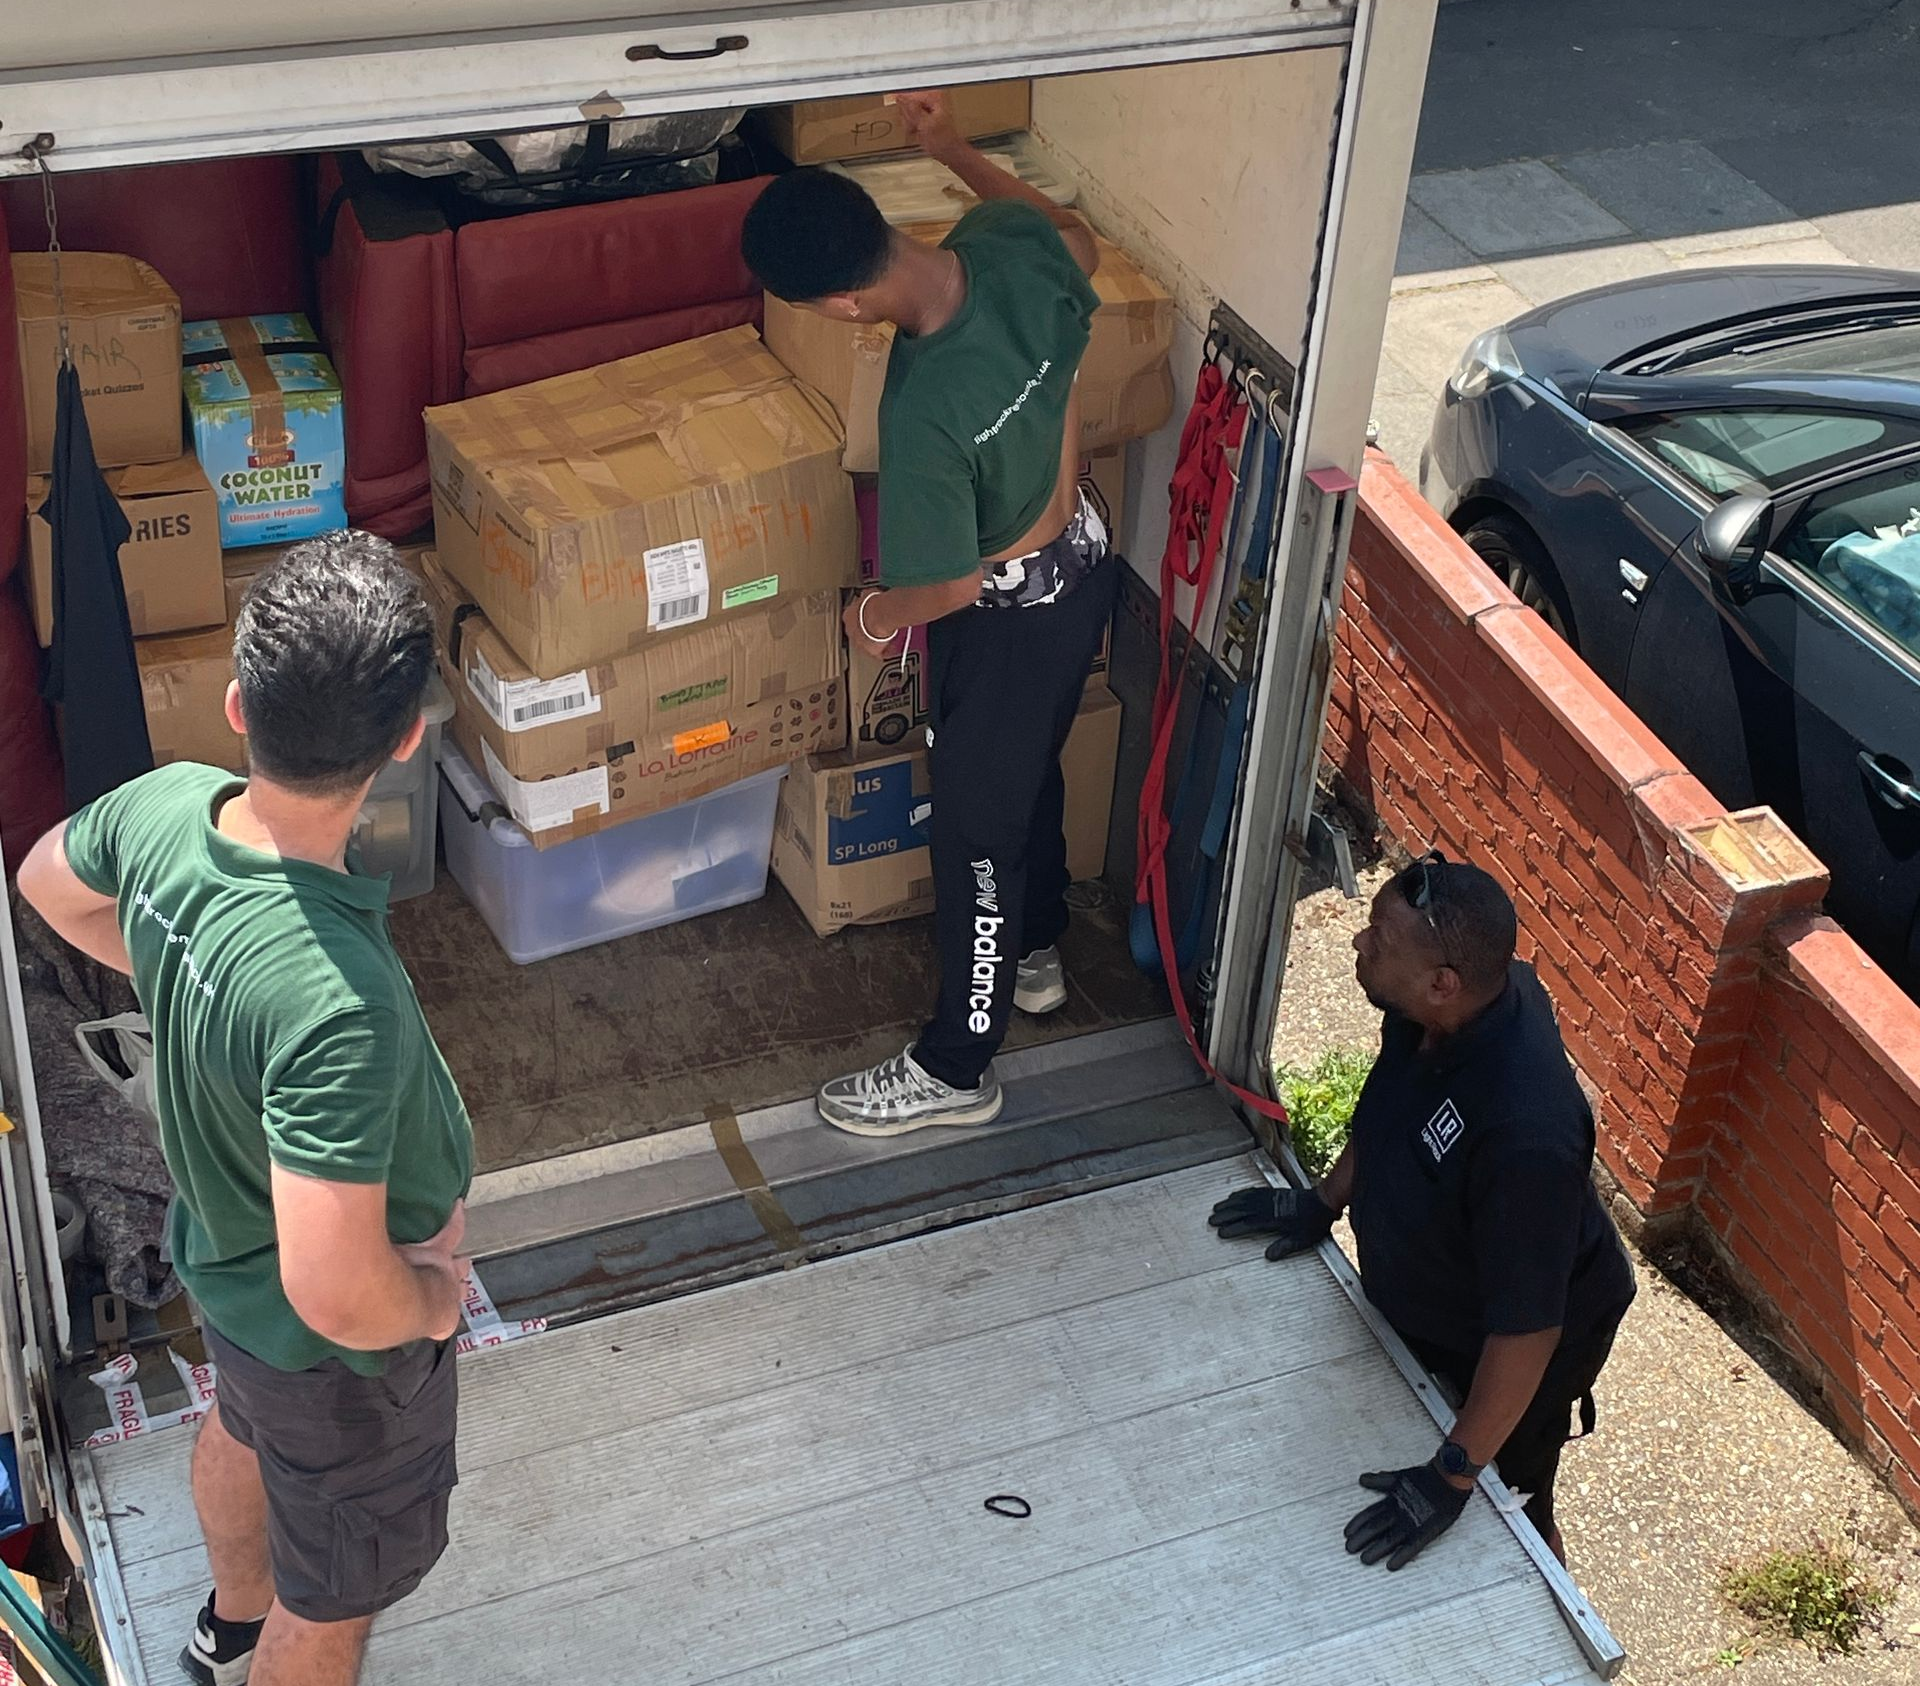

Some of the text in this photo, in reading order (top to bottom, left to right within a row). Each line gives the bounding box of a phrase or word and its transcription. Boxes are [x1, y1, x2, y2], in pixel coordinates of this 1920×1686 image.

[850, 119, 893, 147] FD
[53, 336, 142, 379] HAIR
[220, 463, 322, 490] COCONUT
[234, 483, 311, 506] WATER
[134, 513, 192, 542] RIES
[229, 505, 321, 523] Ultimate Hydration
[636, 761, 665, 778] La
[669, 729, 759, 769] Lorraine
[852, 776, 882, 796] lus
[835, 838, 898, 861] SP Long
[967, 857, 1004, 1035] new balance
